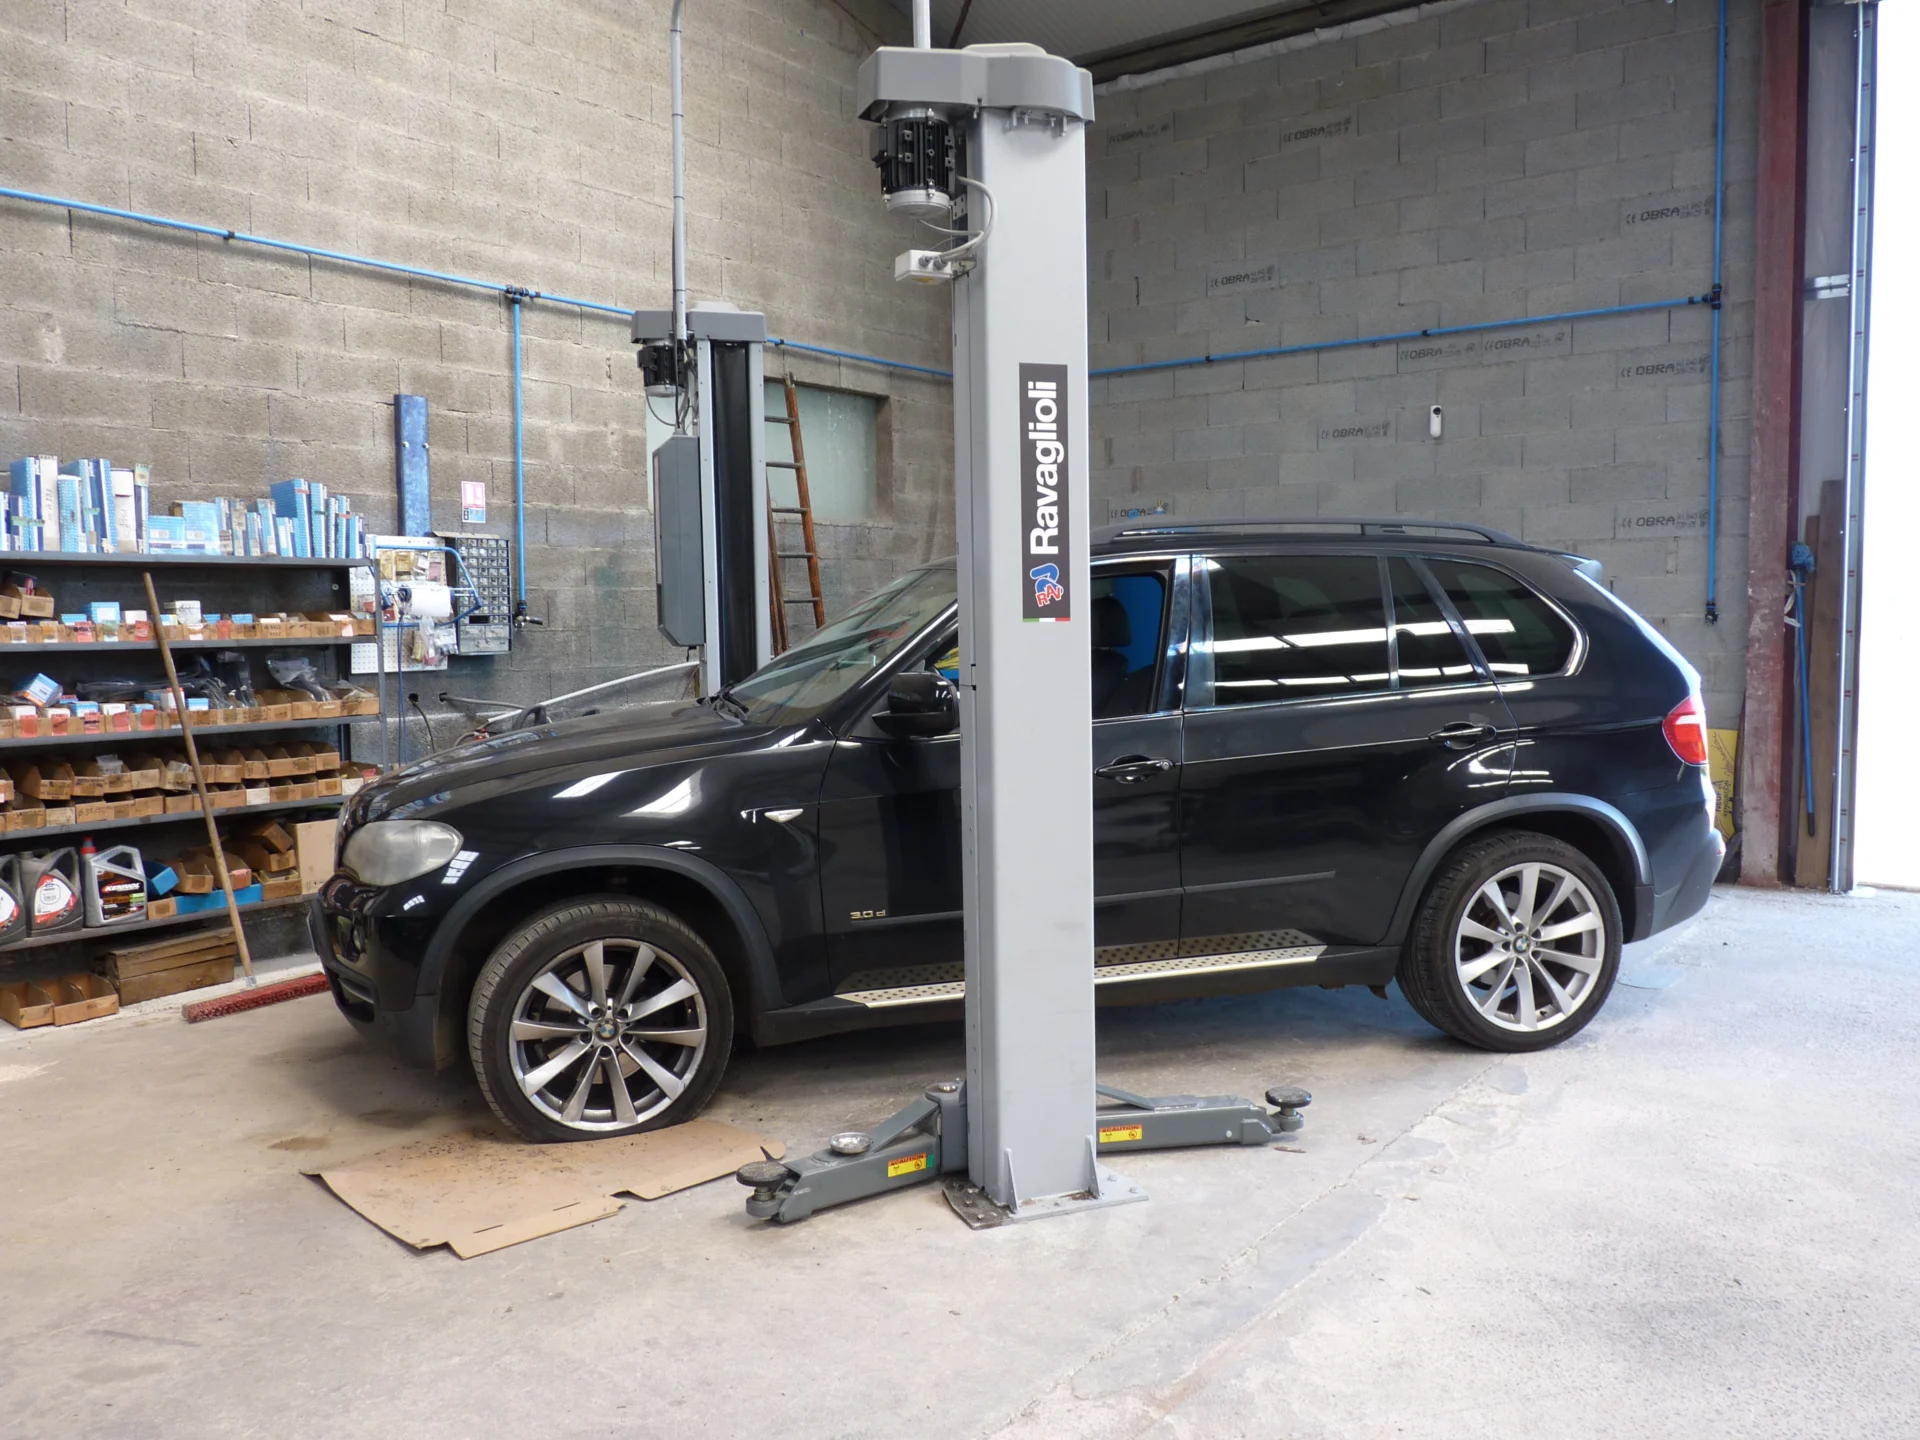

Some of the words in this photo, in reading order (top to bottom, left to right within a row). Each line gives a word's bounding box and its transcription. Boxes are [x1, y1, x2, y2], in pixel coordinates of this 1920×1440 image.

[1294, 126, 1326, 140] OBRA
[1640, 207, 1680, 221] OBRA
[1221, 273, 1250, 285] OBRA
[1494, 337, 1530, 350] OBRA
[1409, 347, 1443, 360] OBRA
[1635, 363, 1676, 376] OBRA
[1332, 427, 1364, 439] OBRA
[1027, 381, 1065, 554] Ravaglioli
[1635, 516, 1676, 527] OBRA
[1035, 583, 1062, 607] RAV
